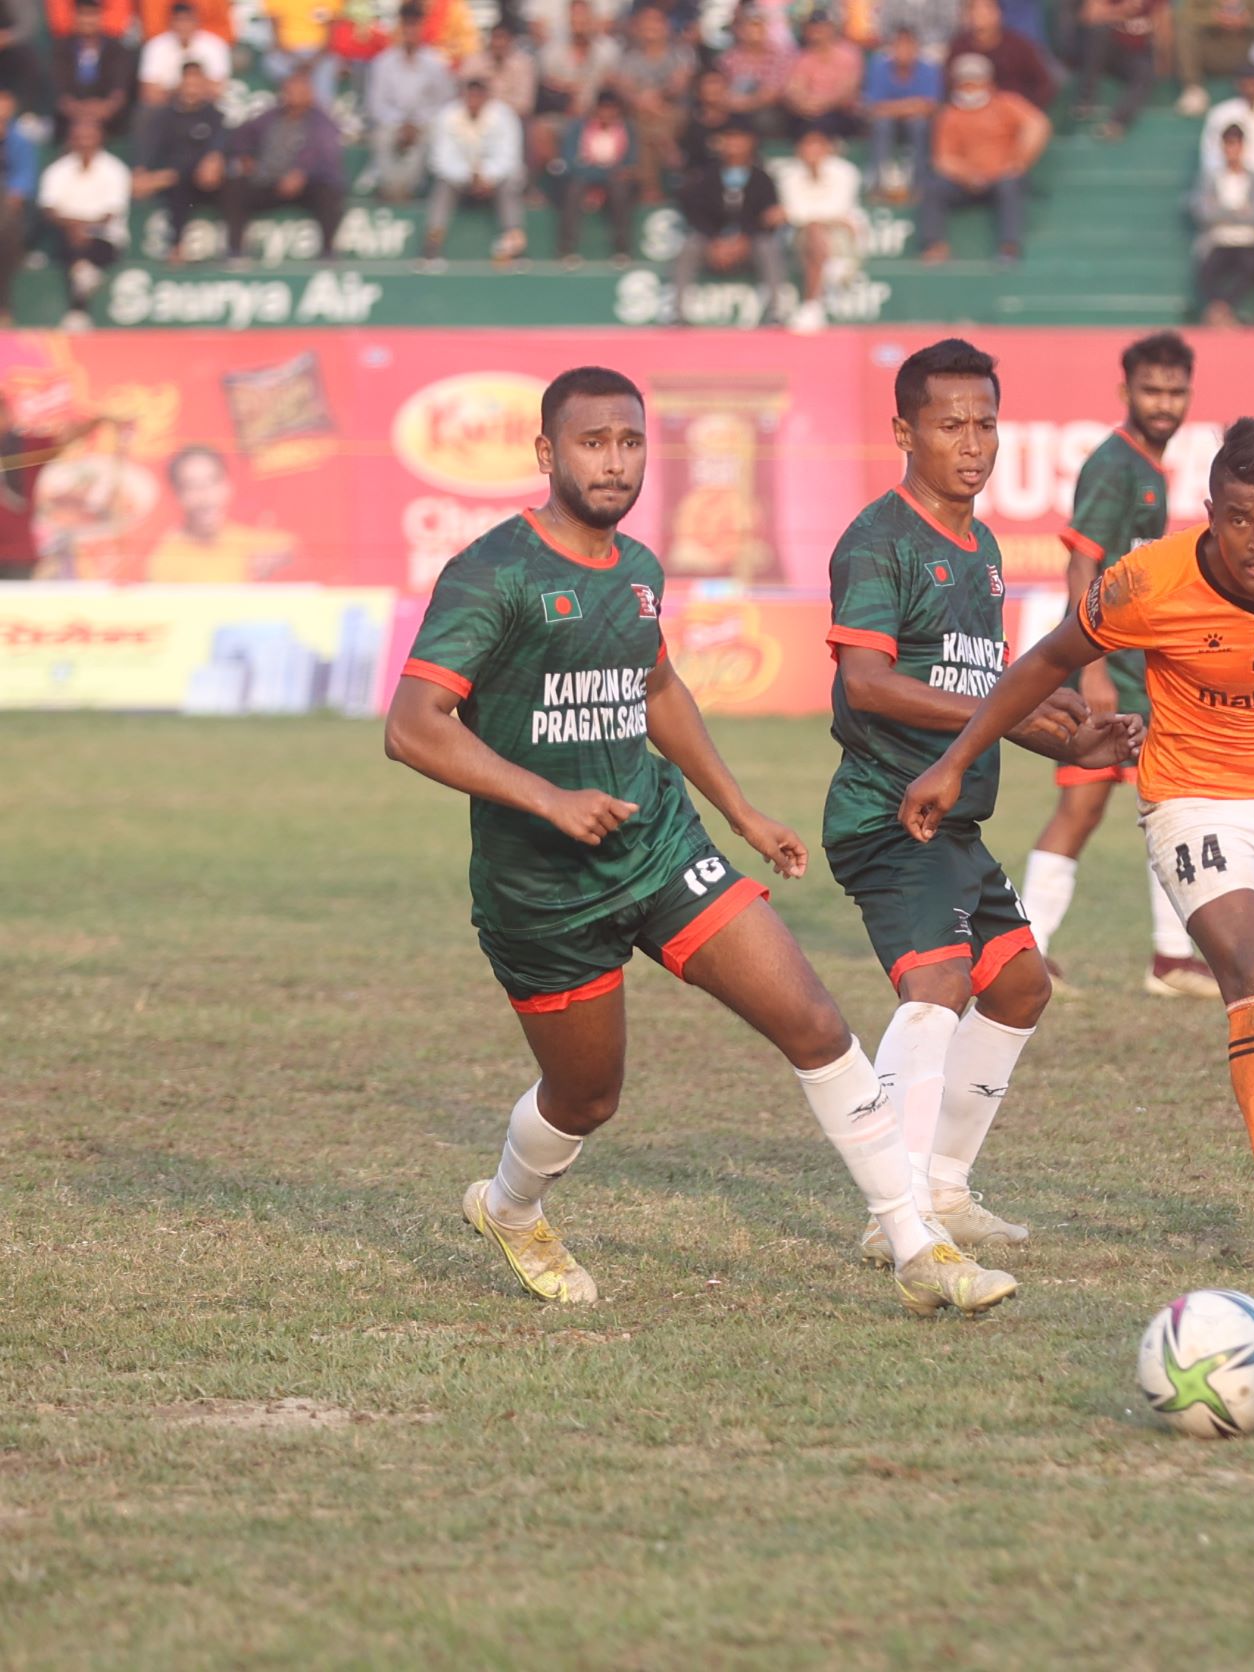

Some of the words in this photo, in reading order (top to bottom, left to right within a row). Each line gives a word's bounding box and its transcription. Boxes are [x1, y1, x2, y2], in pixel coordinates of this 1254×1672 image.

[332, 207, 414, 258] Air
[108, 269, 292, 331] Saurya
[295, 270, 382, 323] Air
[1175, 833, 1227, 885] 44
